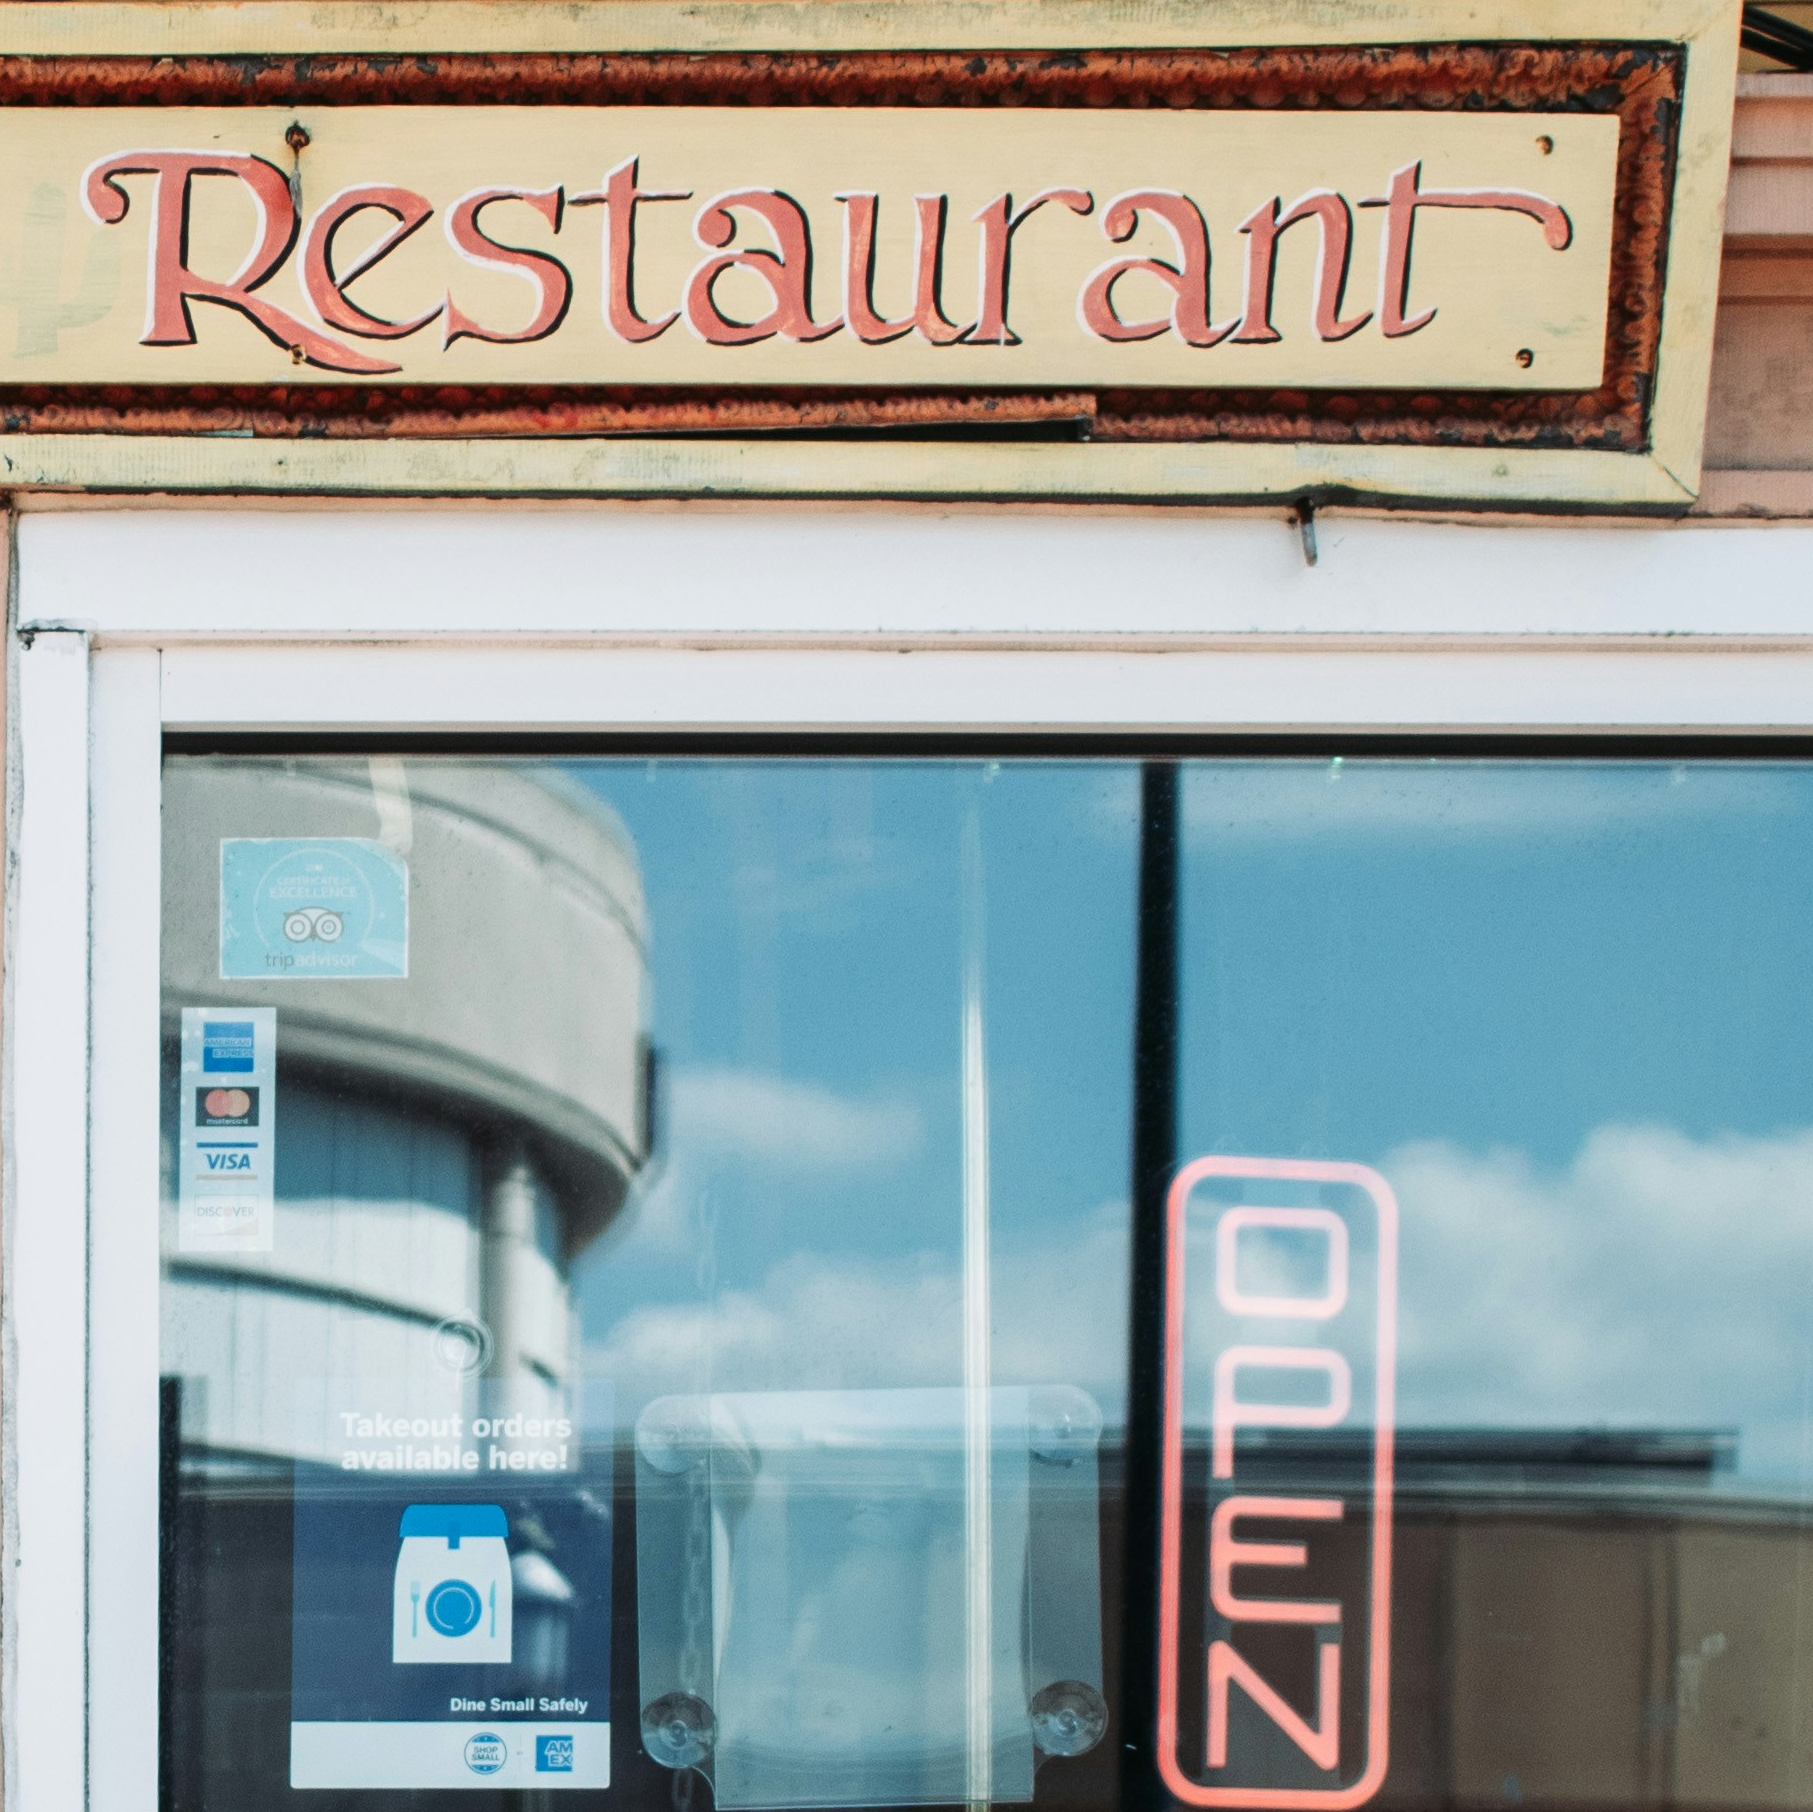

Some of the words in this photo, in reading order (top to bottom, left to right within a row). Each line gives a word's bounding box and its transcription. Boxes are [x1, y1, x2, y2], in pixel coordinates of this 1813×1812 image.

[81, 149, 1573, 376] Restaurant
[204, 1153, 251, 1169] VISA
[196, 1206, 255, 1217] DISCOVER
[340, 1412, 464, 1438] Takeout
[471, 1412, 572, 1438] orders
[341, 1444, 480, 1471] available
[489, 1444, 568, 1470] here!
[1206, 1205, 1352, 1771] OPEN
[450, 1697, 486, 1712] Dine
[490, 1697, 535, 1712] Small
[539, 1697, 588, 1715] Safely
[471, 1753, 500, 1762] SMALL
[473, 1745, 499, 1754] SHOP
